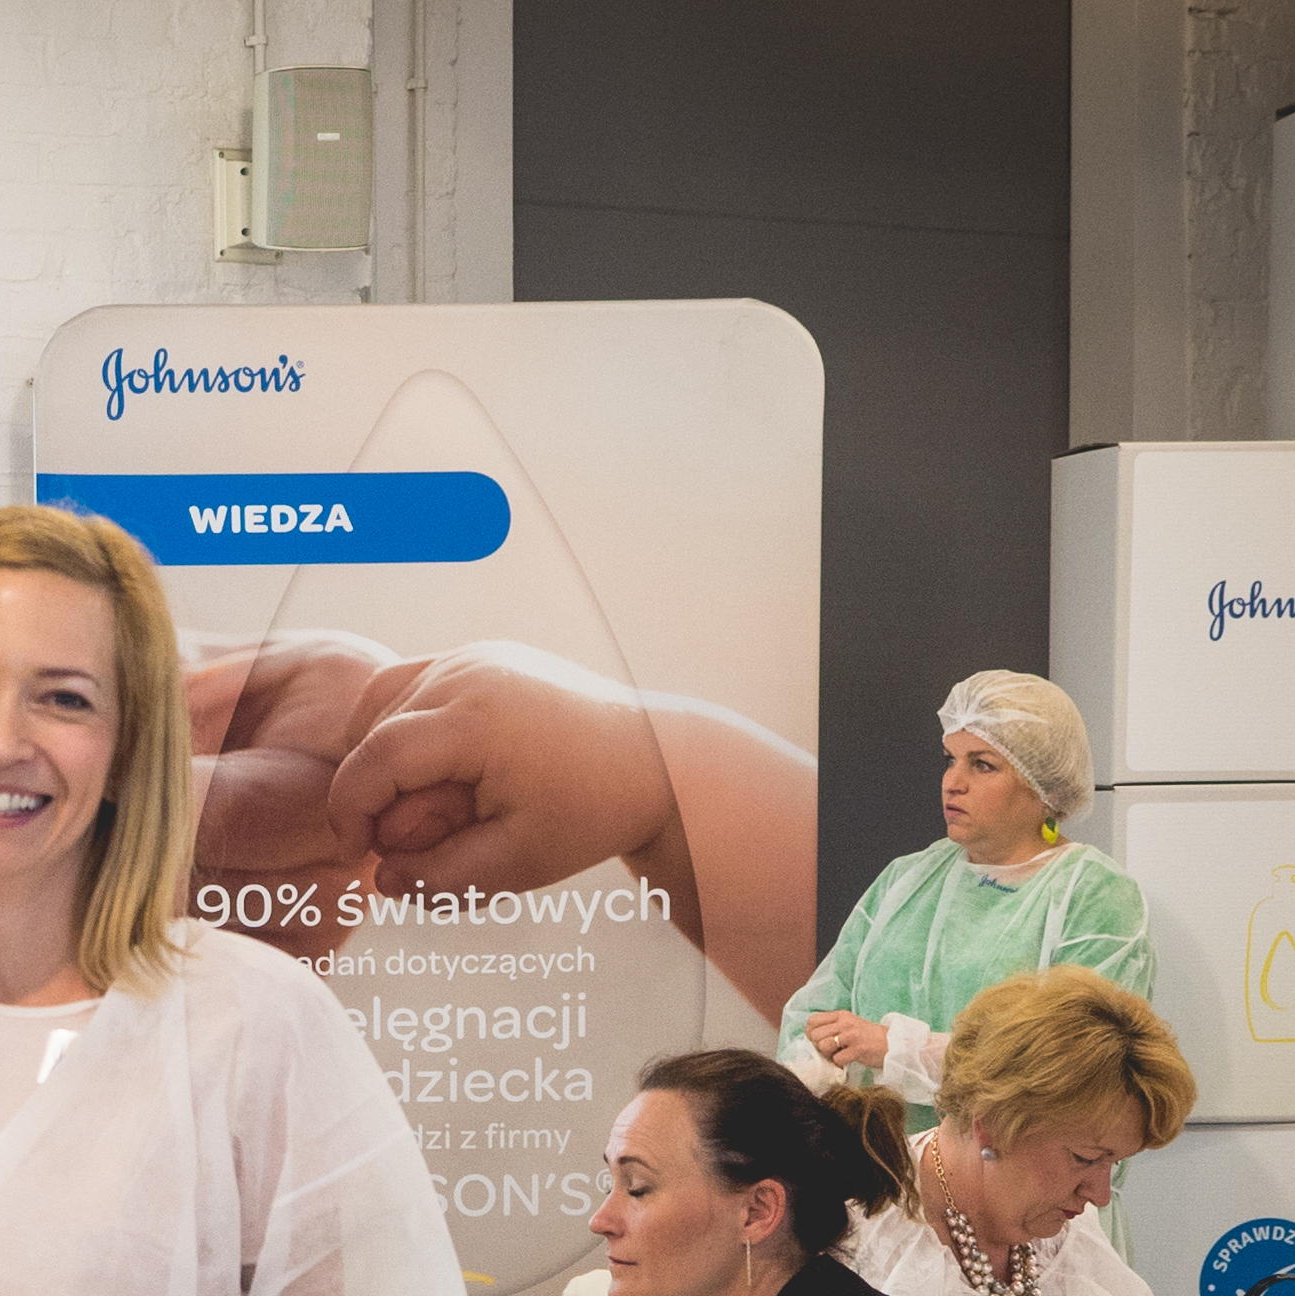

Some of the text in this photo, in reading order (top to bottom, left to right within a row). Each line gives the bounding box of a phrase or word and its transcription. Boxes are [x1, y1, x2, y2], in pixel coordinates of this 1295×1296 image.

[189, 504, 354, 534] WIEDZA
[196, 876, 671, 934] 90% światowych
[385, 945, 595, 981] dotyczących
[383, 1056, 593, 1103] dziecka
[460, 1130, 476, 1149] z
[485, 1122, 571, 1154] firmy
